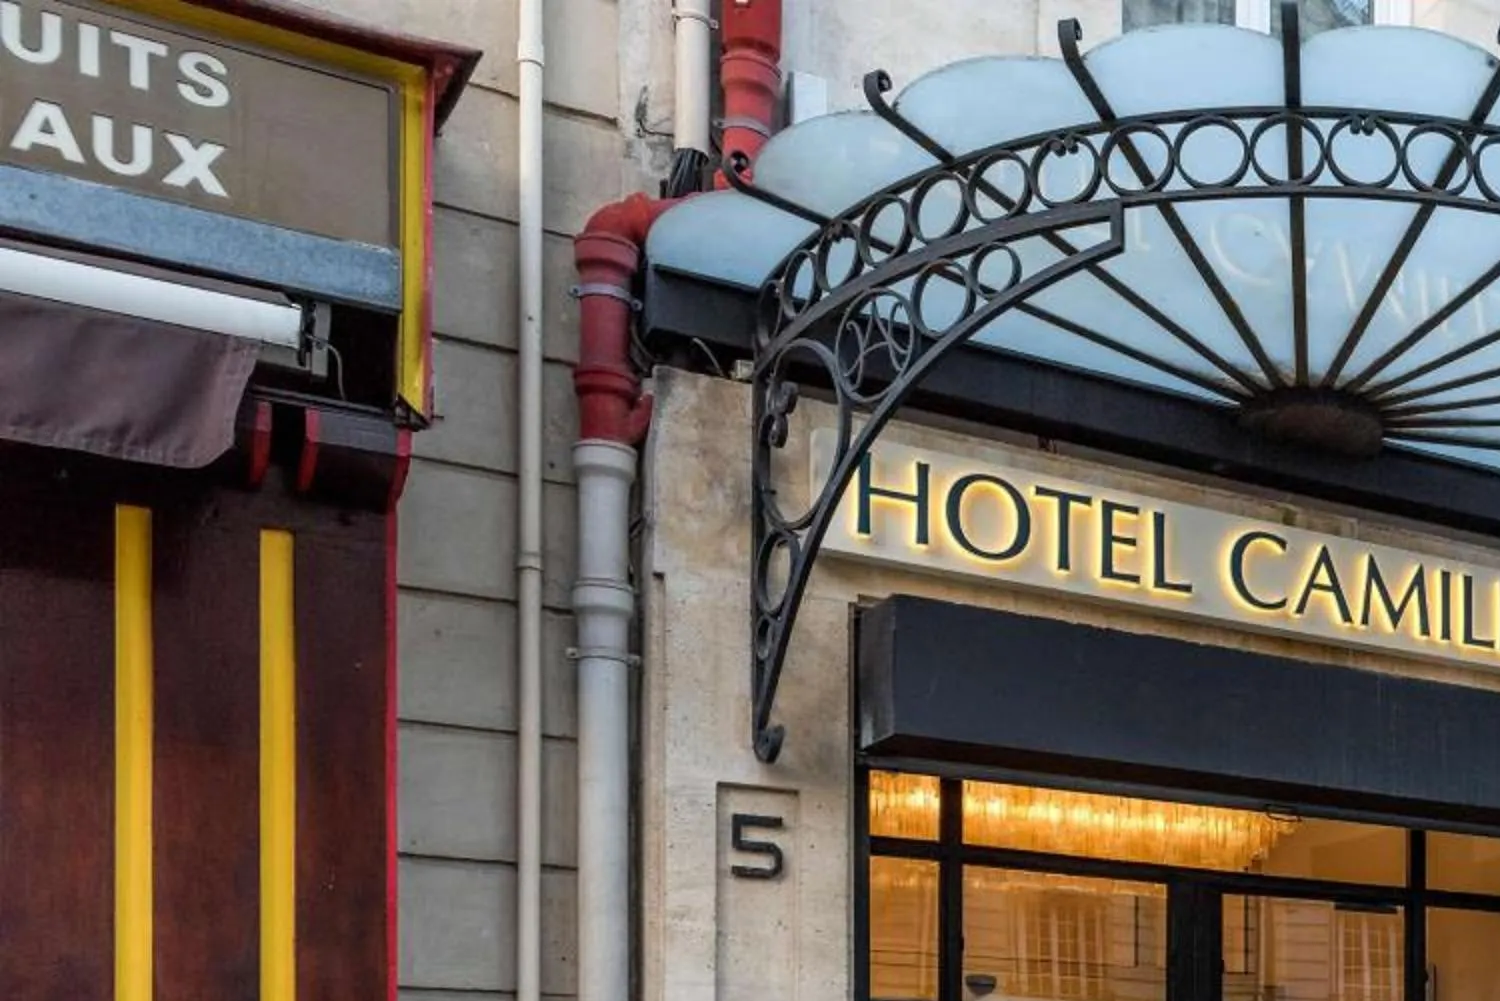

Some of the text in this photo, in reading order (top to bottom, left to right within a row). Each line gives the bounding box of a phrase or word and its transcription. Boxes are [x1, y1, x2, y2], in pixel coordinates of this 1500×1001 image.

[0, 1, 230, 107] UITS
[10, 99, 228, 198] AUX
[857, 451, 1193, 594] HOTEL
[731, 813, 783, 879] 5
